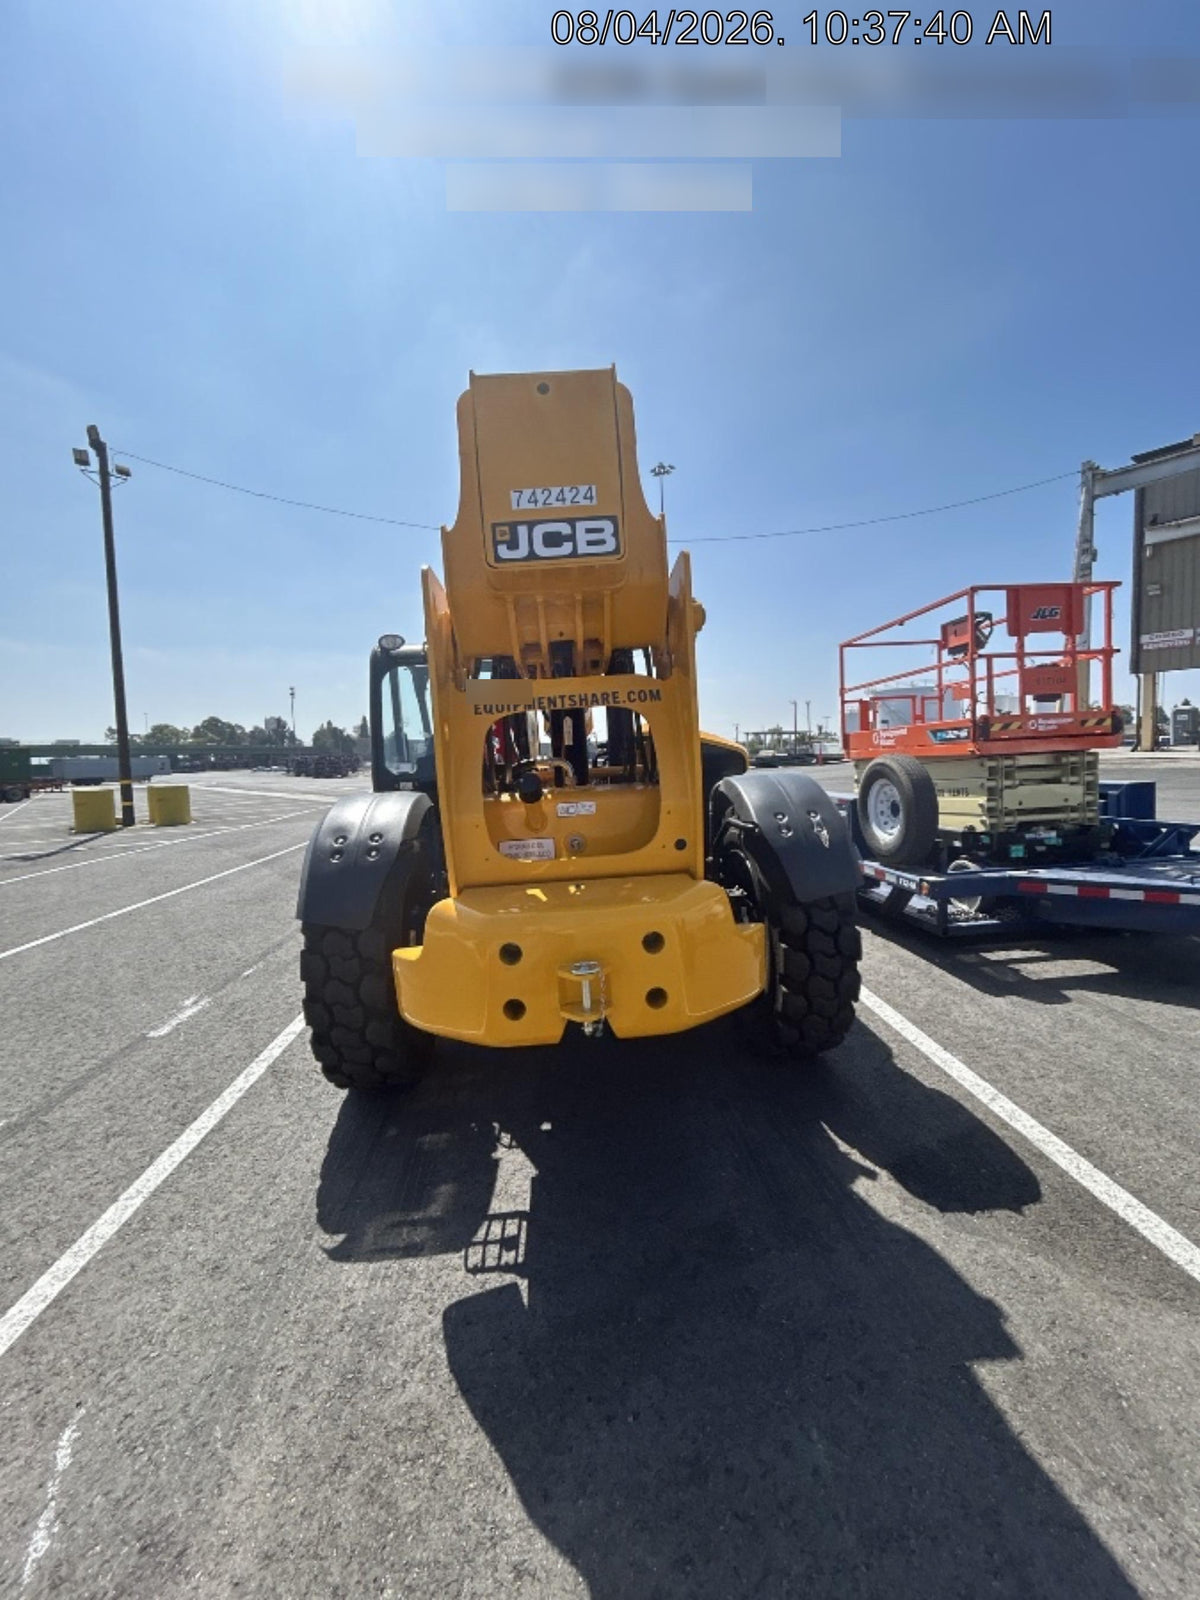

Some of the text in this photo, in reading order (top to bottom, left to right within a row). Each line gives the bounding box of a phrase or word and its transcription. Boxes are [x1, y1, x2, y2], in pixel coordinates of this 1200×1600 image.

[513, 486, 594, 507] 742424
[497, 520, 617, 558] JCB
[1030, 606, 1060, 619] JLG
